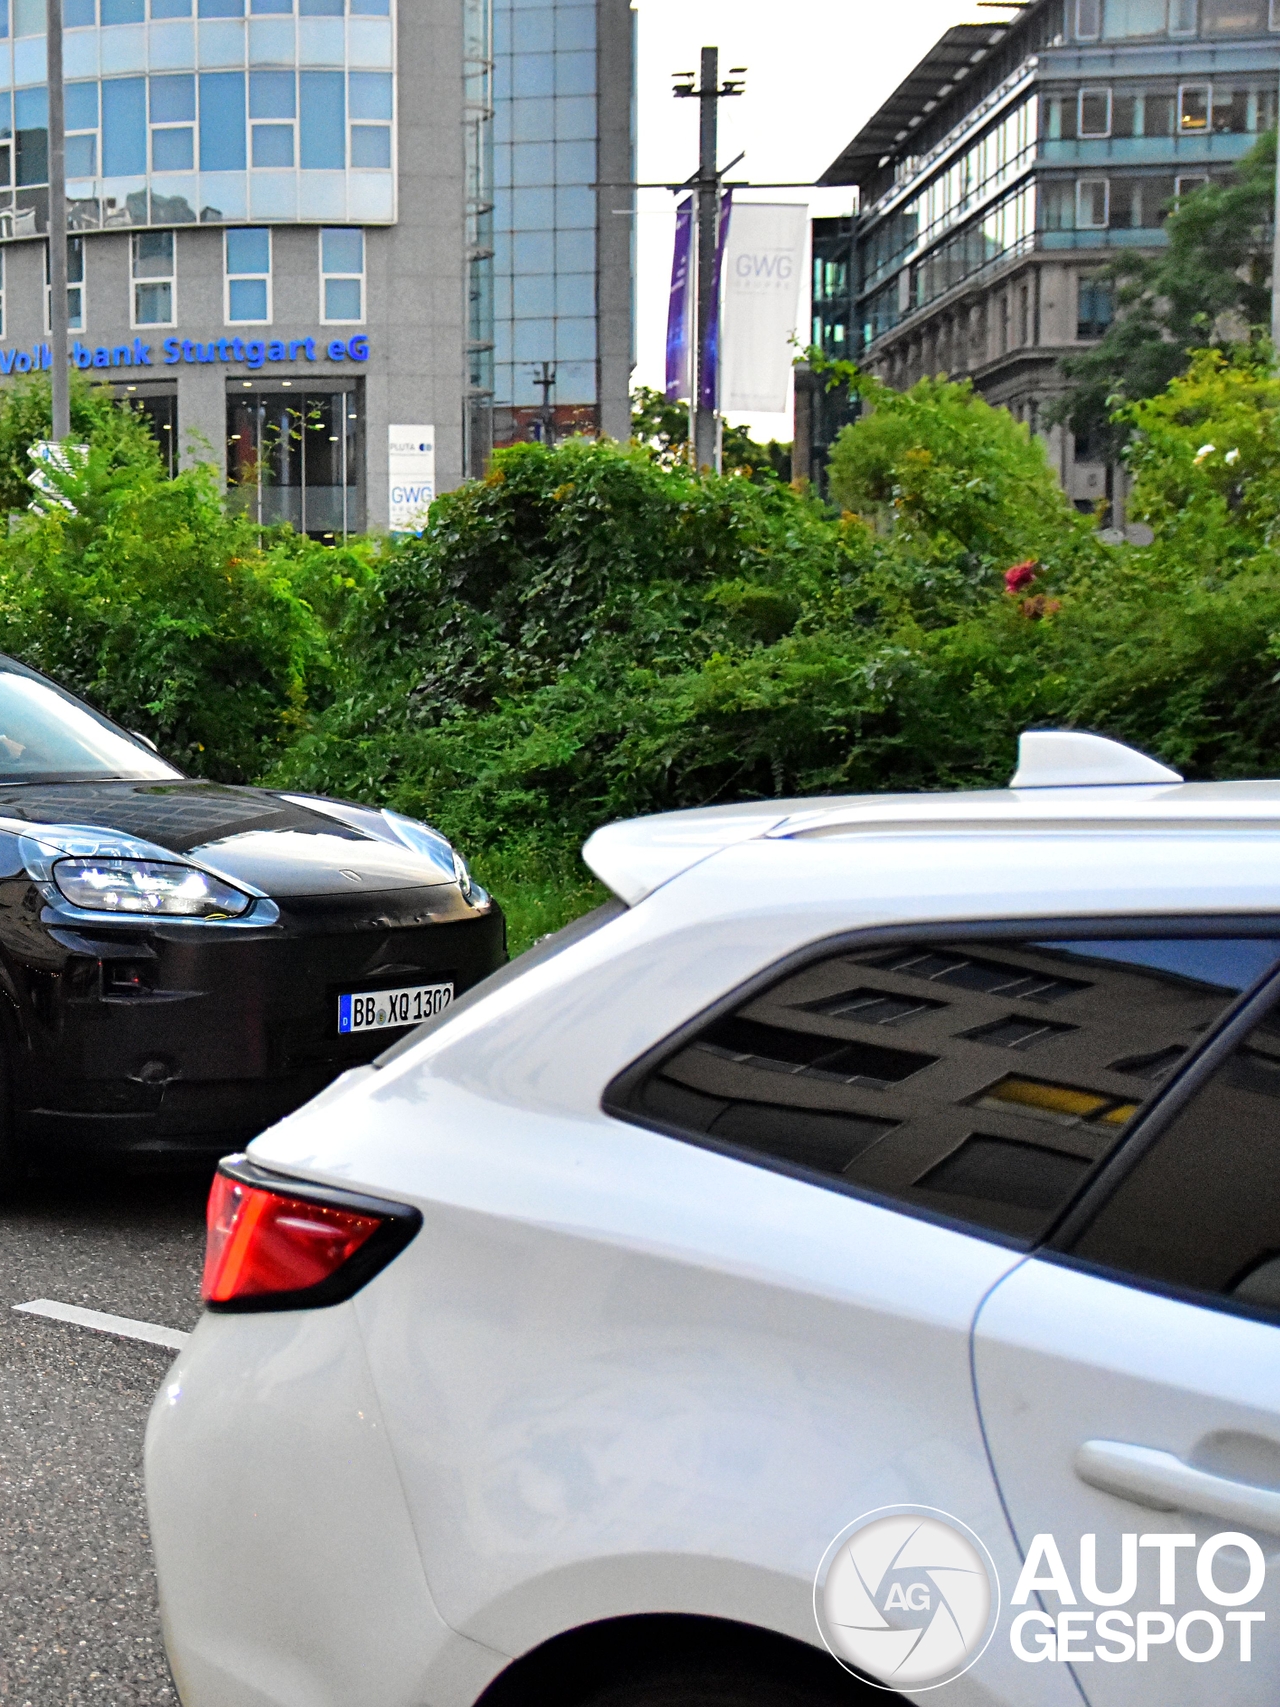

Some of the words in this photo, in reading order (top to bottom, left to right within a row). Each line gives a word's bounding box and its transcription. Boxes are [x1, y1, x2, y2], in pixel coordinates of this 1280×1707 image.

[736, 253, 792, 279] GWG
[163, 335, 317, 369] Stuttgart
[327, 334, 370, 362] eG
[392, 486, 433, 504] GWG
[353, 997, 376, 1027] BB
[388, 993, 409, 1023] XQ
